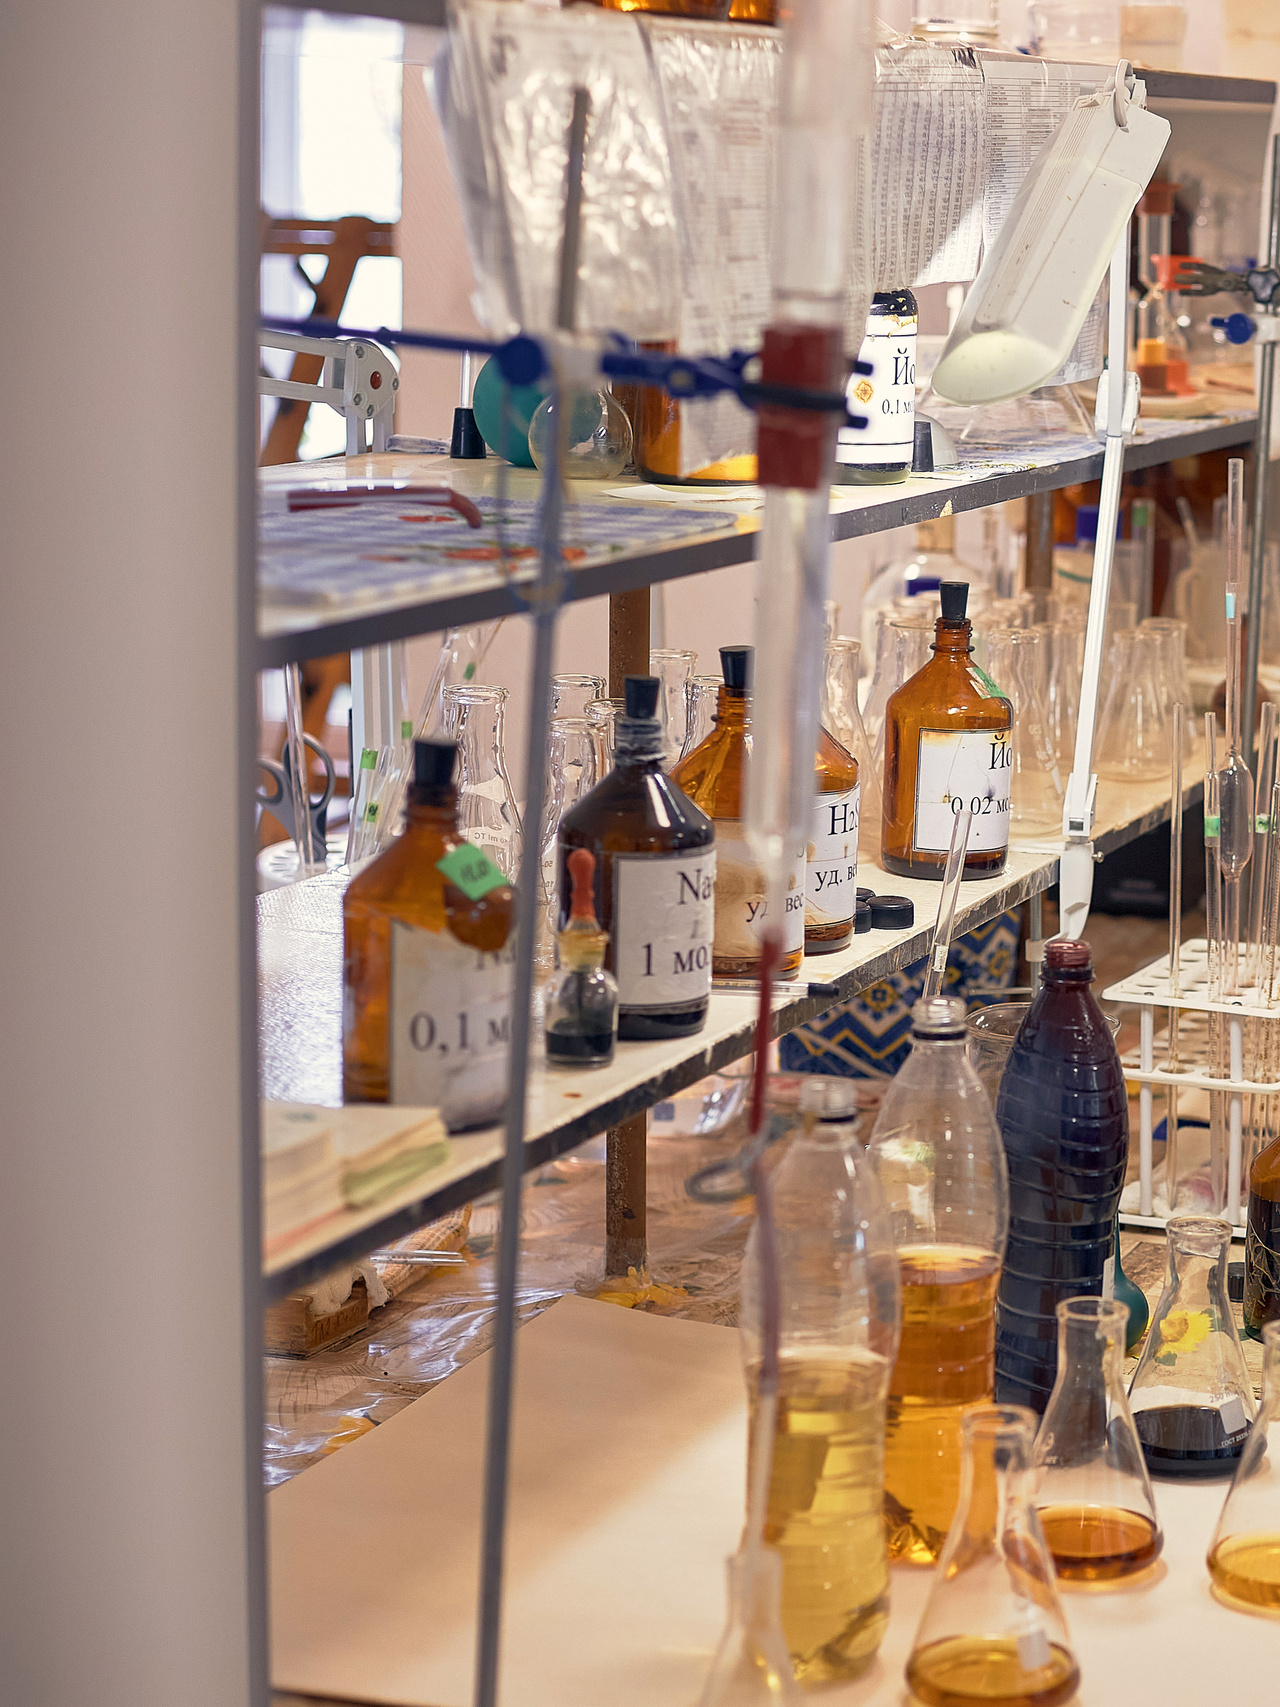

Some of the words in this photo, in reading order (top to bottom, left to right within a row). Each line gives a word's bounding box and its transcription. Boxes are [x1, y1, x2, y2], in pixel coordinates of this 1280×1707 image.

[882, 399, 900, 415] 0,1
[951, 796, 991, 815] 002
[815, 869, 843, 892] уд.
[642, 942, 655, 977] 1
[408, 1010, 470, 1056] 0,1
